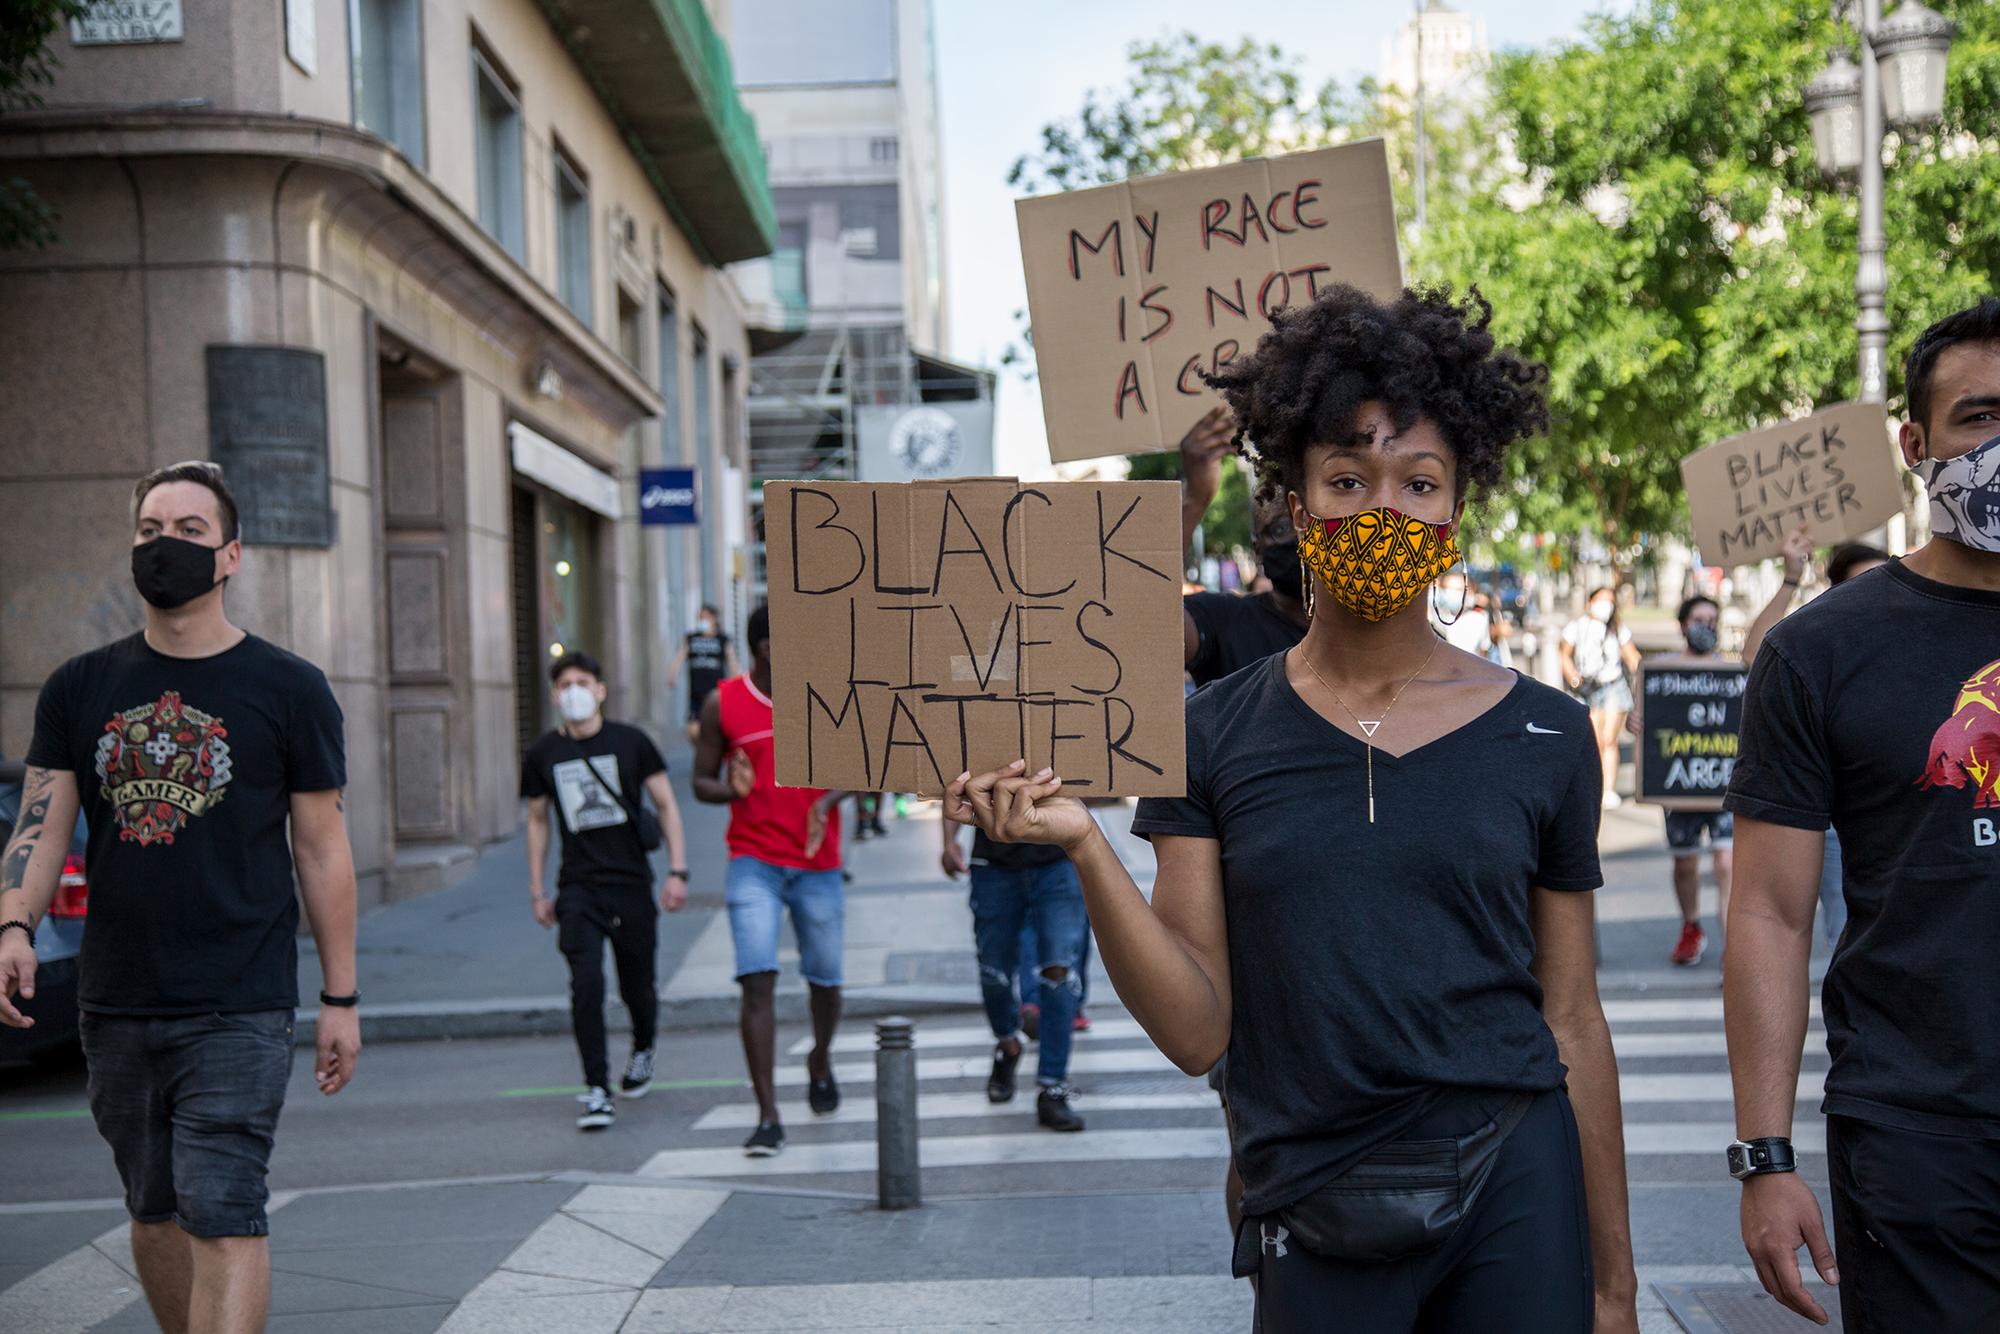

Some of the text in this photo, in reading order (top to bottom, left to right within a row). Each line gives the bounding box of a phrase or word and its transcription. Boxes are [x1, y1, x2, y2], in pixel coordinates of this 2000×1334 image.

[1069, 179, 1329, 281] MY RACE
[1119, 262, 1331, 344] IS NOT
[1115, 360, 1149, 420] A
[1725, 423, 1847, 490] BLACK
[1734, 454, 1846, 517] LIVES
[790, 487, 1172, 600] BLACK
[1718, 482, 1863, 557] MATTER
[847, 597, 1122, 697] LIVES
[806, 682, 1165, 793] MATTER
[118, 782, 198, 810] GAMER
[1973, 817, 2000, 847] B
